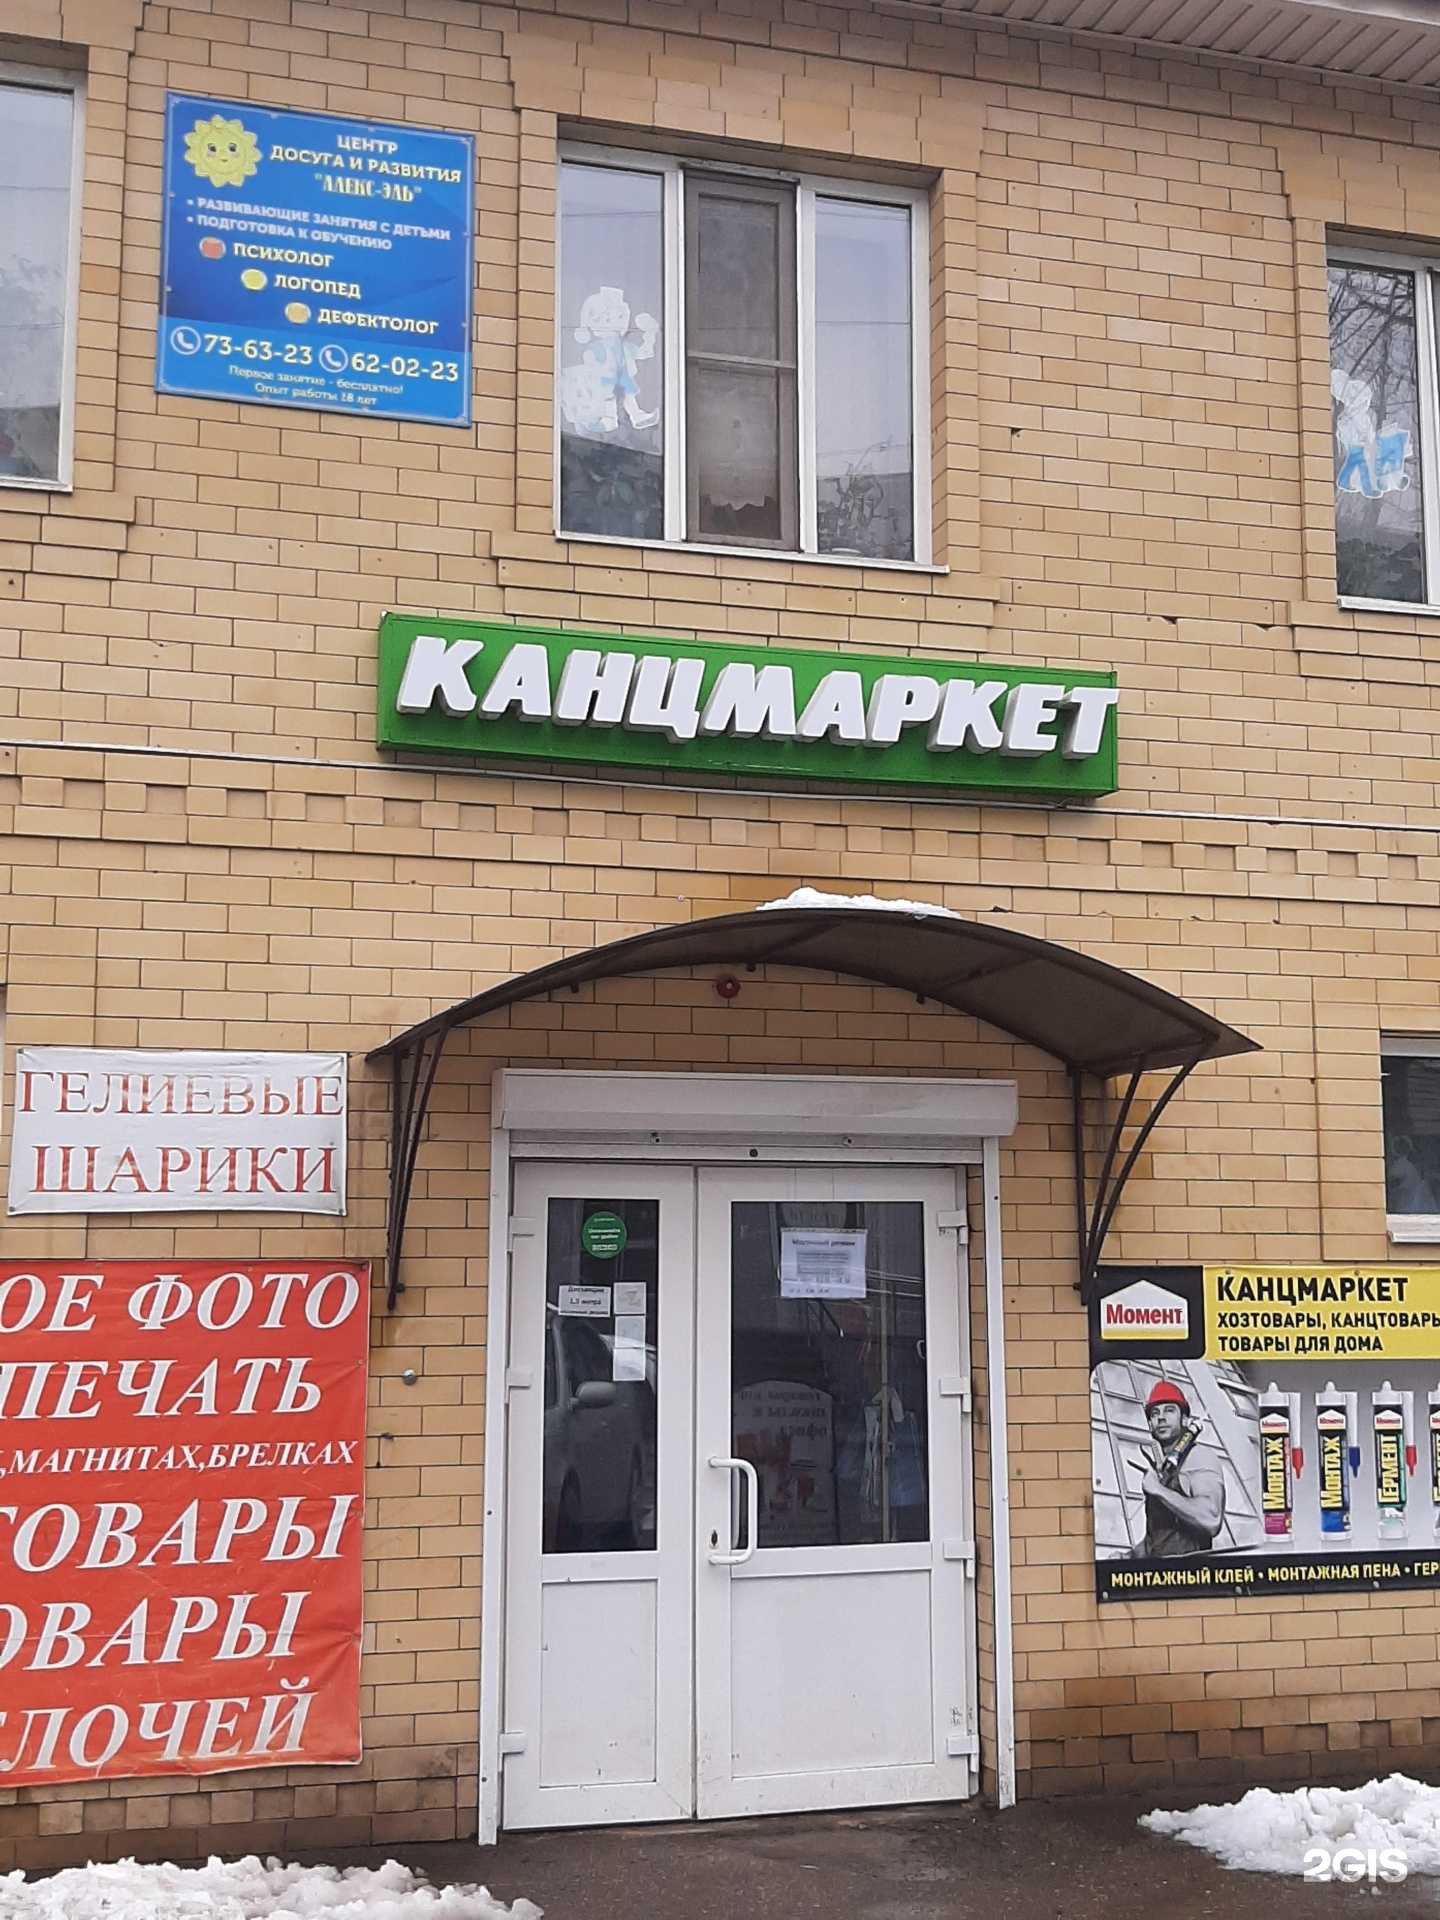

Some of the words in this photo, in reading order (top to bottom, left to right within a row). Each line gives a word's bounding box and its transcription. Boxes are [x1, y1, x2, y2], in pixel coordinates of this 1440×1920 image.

[336, 134, 399, 154] ЦЕНТР
[270, 145, 344, 168] ДОСУГА
[349, 156, 363, 171] И
[368, 159, 462, 183] РАЗВИТИЯ
[197, 198, 310, 222] РАЗВИВАЮЩИЕ
[313, 212, 377, 232] ЗАНЯТИЯ
[380, 222, 390, 233] С
[392, 224, 451, 240] ДЕТЬМИ
[197, 214, 295, 238] ПОДГОТОВКА
[299, 227, 309, 240] К
[311, 229, 393, 250] ОБУЧЕНИЮ
[233, 242, 334, 267] ПСИХОЛОГ
[274, 274, 361, 299] ЛОГОПЕД
[317, 308, 439, 335] ДЕФЕКТОЛОГ
[203, 334, 313, 365] 73-63-23
[351, 353, 459, 382] 62-02-23
[397, 635, 1119, 757] КАНЦМАРКЕТ
[18, 1070, 345, 1115] ГЕЛИЕВЫЕ
[29, 1145, 338, 1193] ШАРИКИ
[127, 1272, 360, 1330] ФОТО
[1217, 1276, 1409, 1306] КАНЦМАРКЕТ
[1106, 1303, 1183, 1325] Момент
[1218, 1312, 1327, 1330] ХОЗТОВАРЫ,
[1218, 1336, 1290, 1352] ТОВАРЫ
[1294, 1336, 1331, 1355] ДЛЯ
[1334, 1336, 1383, 1355] ДОМА
[0, 1357, 322, 1420] ПЕЧАТЬ
[1111, 1566, 1211, 1588] МОНТАЖНЫЙ
[1214, 1565, 1254, 1583] КЛЕЙ
[1268, 1564, 1360, 1582] МОНТАЖНАЯ
[1363, 1562, 1400, 1578] ПЕНА
[0, 1677, 319, 1770] ЛОЧЕЙ
